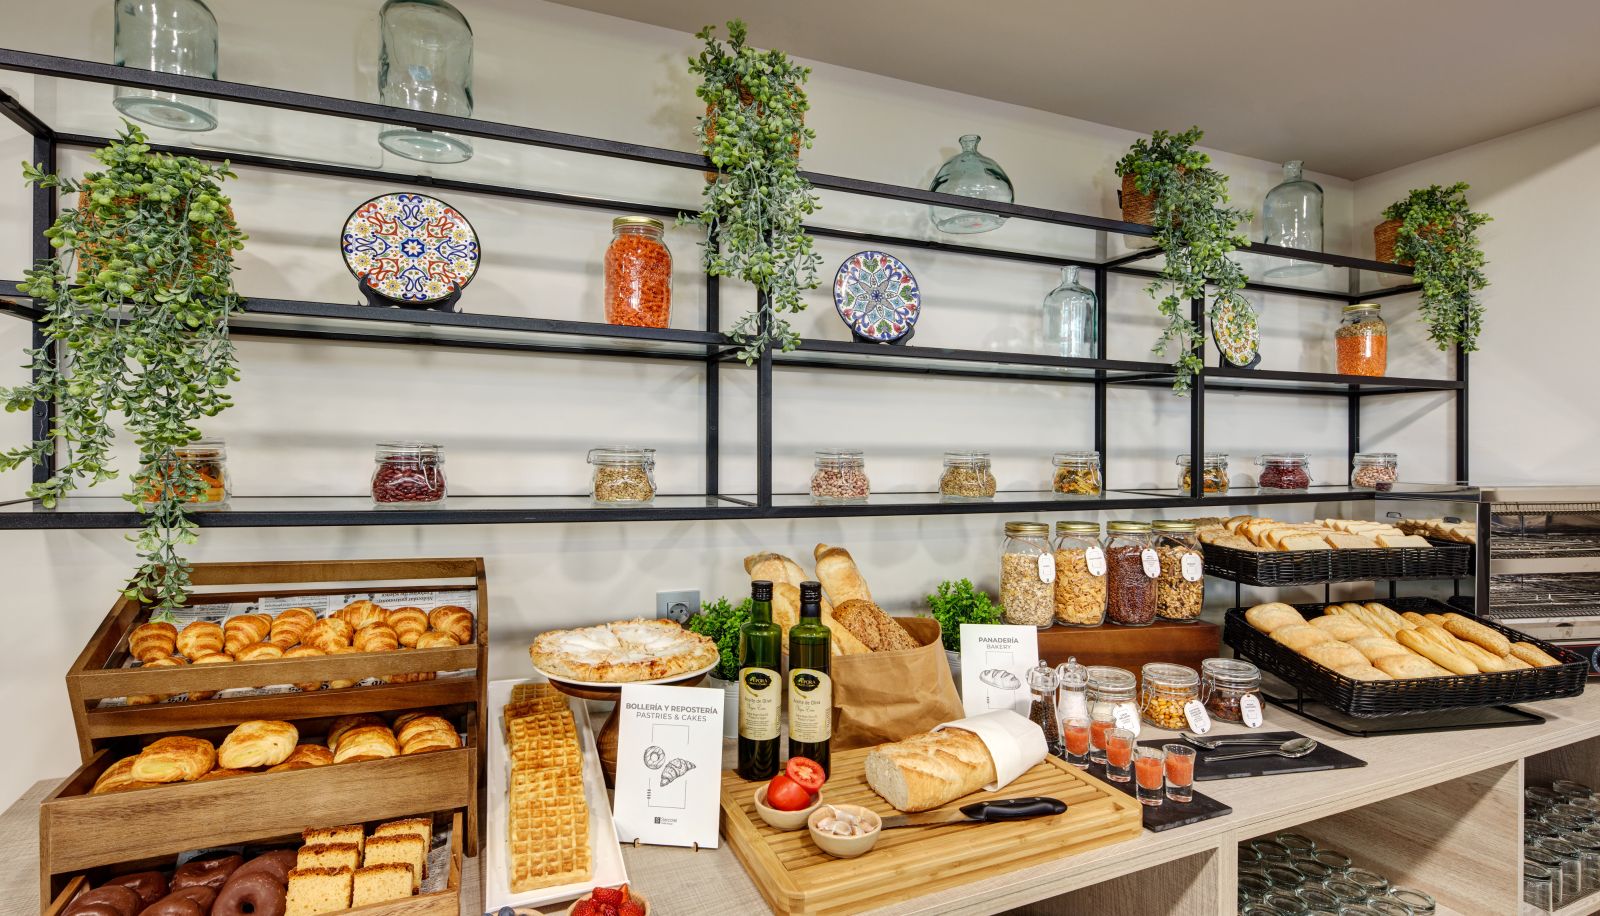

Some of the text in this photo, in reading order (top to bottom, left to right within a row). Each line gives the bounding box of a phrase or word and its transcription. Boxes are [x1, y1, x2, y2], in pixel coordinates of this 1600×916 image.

[625, 702, 662, 711] BOLLERÍA
[671, 705, 718, 714] REPOSTERÍA
[636, 711, 672, 720] PASTRIES
[681, 714, 707, 722] CAKES
